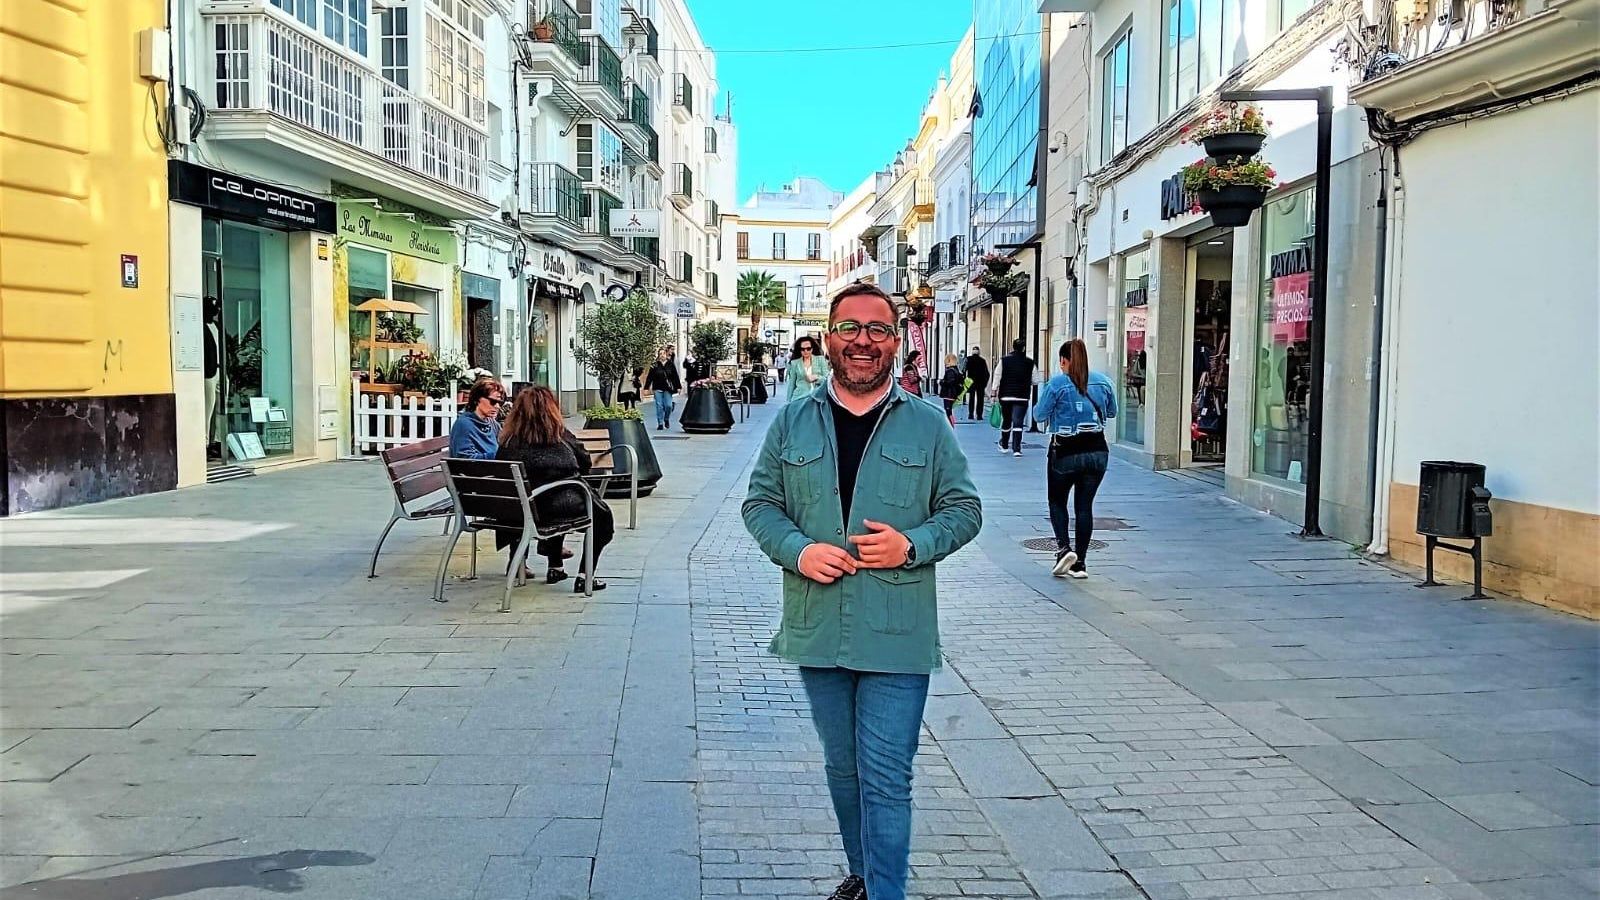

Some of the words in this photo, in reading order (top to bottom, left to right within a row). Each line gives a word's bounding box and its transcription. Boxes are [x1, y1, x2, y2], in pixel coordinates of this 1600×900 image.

[341, 209, 355, 233] Las
[358, 216, 392, 243] Mimosas
[1272, 248, 1307, 277] PAYMA
[1277, 289, 1304, 308] ÚLTIMOS
[1276, 308, 1303, 324] PRECIOS
